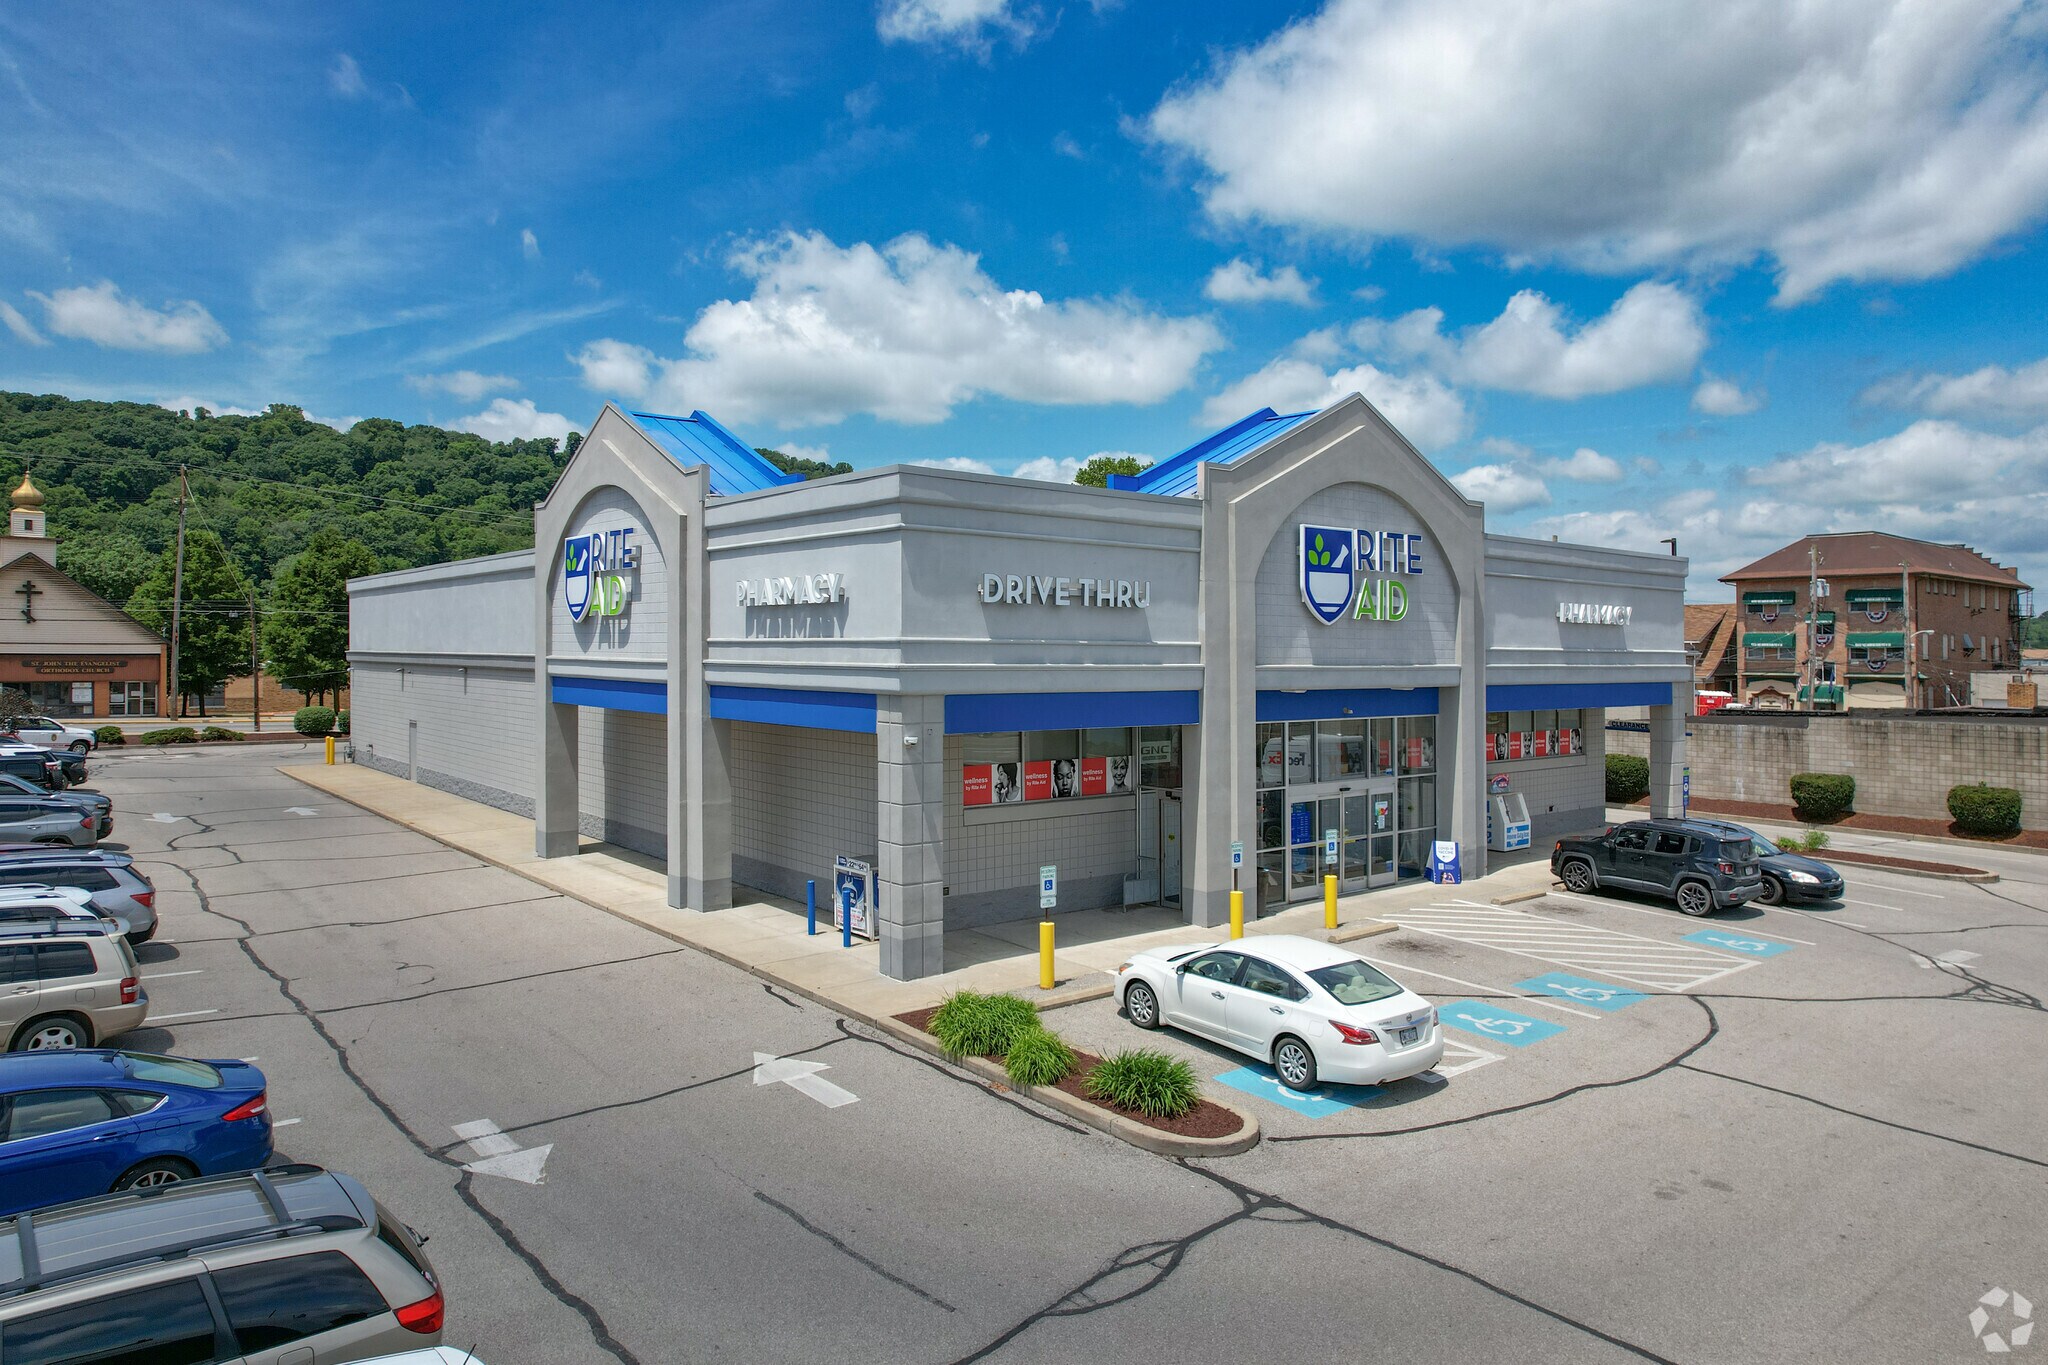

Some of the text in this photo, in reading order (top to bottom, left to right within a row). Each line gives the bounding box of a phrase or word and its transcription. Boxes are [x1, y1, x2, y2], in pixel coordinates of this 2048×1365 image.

[591, 527, 637, 572] RITE
[1354, 529, 1423, 575] RITE
[588, 575, 627, 617] AID
[736, 573, 844, 607] PHARMACY
[982, 573, 1151, 609] DRIVE THRU
[1353, 578, 1409, 621] AID
[1611, 720, 1649, 729] CLEARANCE
[1141, 745, 1170, 755] GNC
